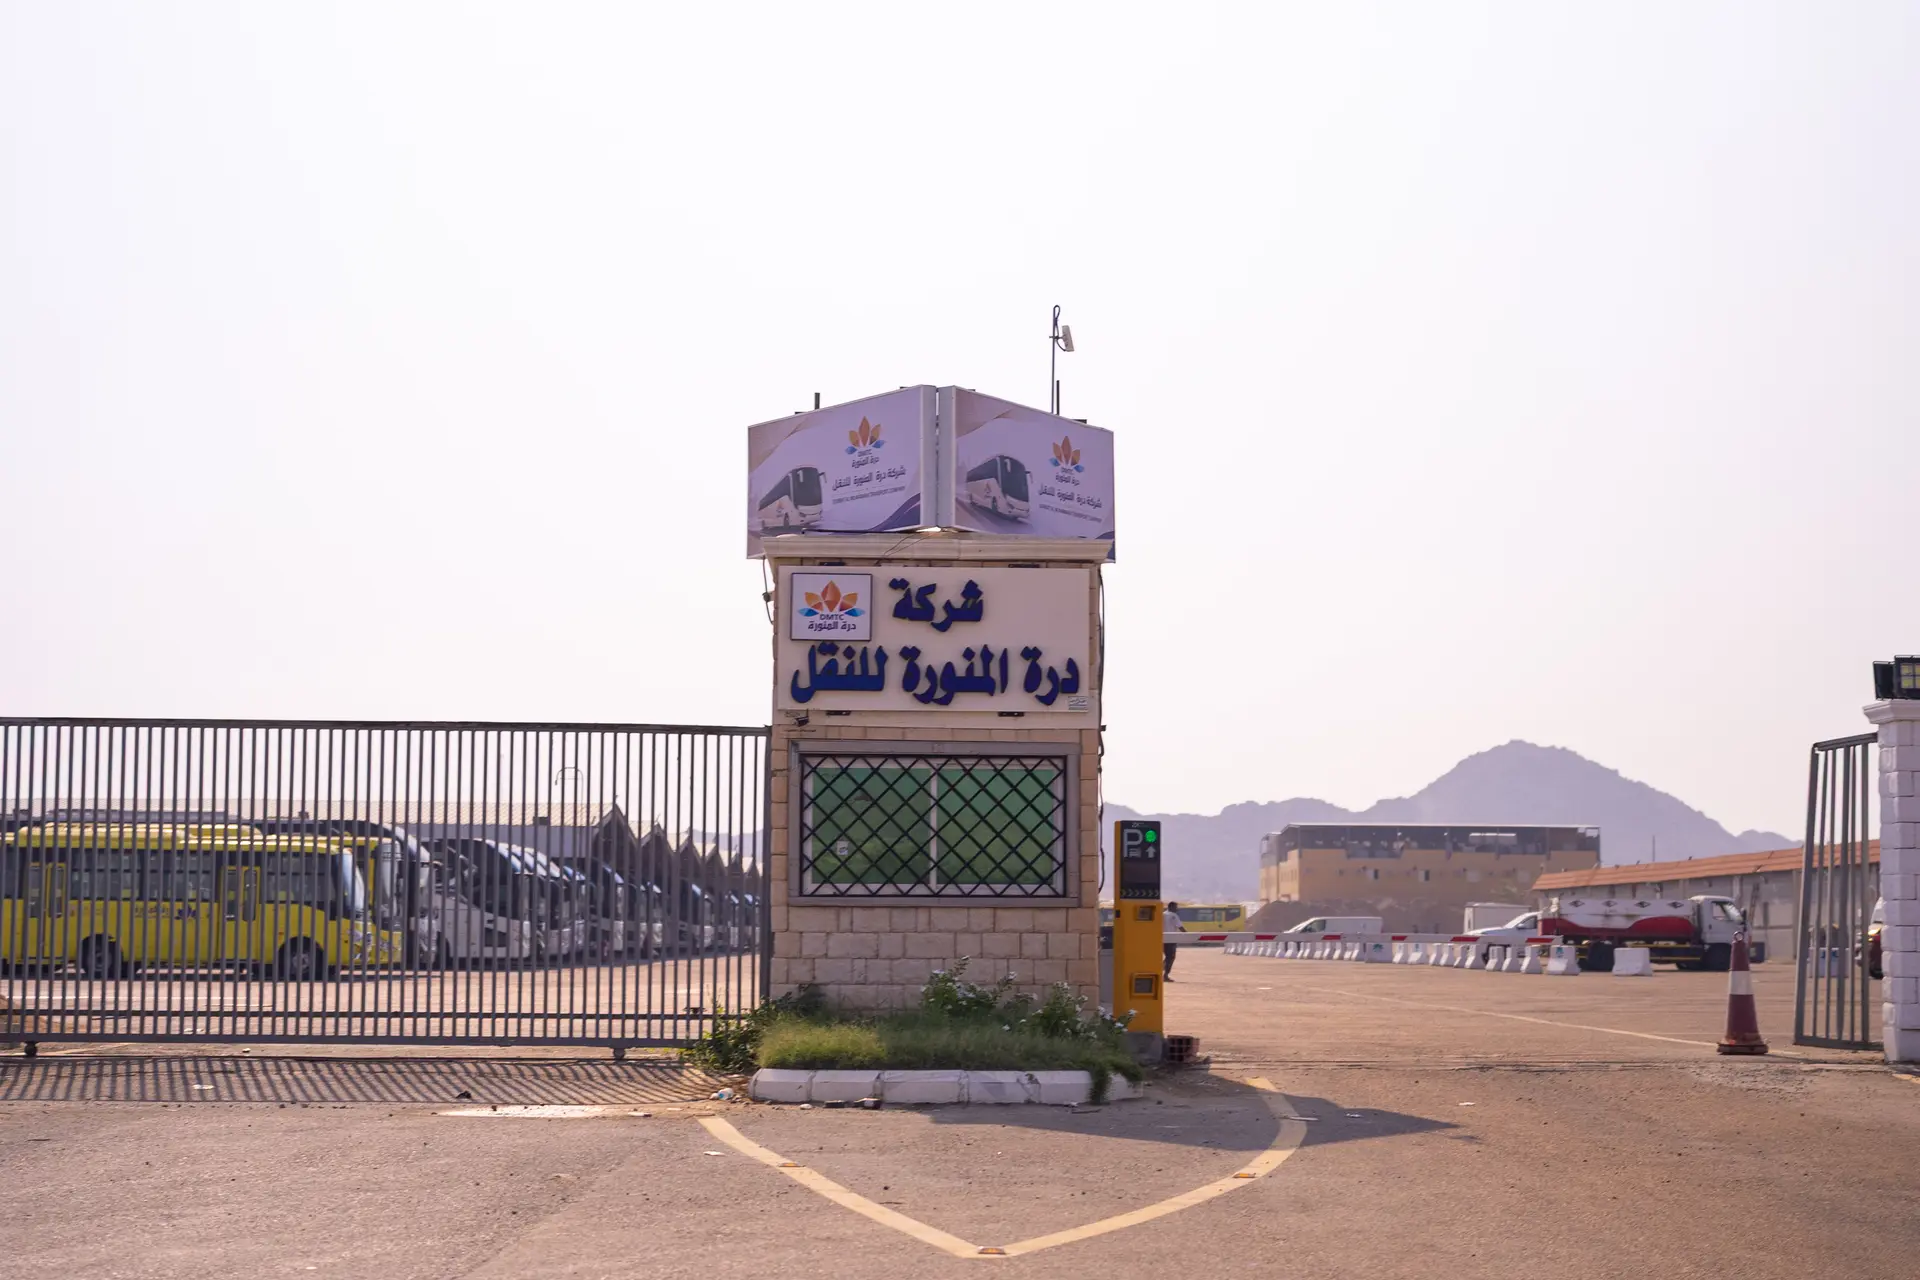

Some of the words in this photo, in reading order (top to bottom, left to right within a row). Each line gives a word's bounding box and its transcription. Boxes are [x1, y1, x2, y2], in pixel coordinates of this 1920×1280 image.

[887, 465, 906, 479] شركة
[819, 613, 845, 621] DMTC
[889, 577, 984, 632] شركة
[807, 620, 839, 632] المنورة
[840, 620, 857, 632] درة
[790, 641, 888, 704] للنقل
[899, 644, 1007, 706] المنورة
[1020, 645, 1080, 706] درة
[1123, 828, 1143, 858] P
